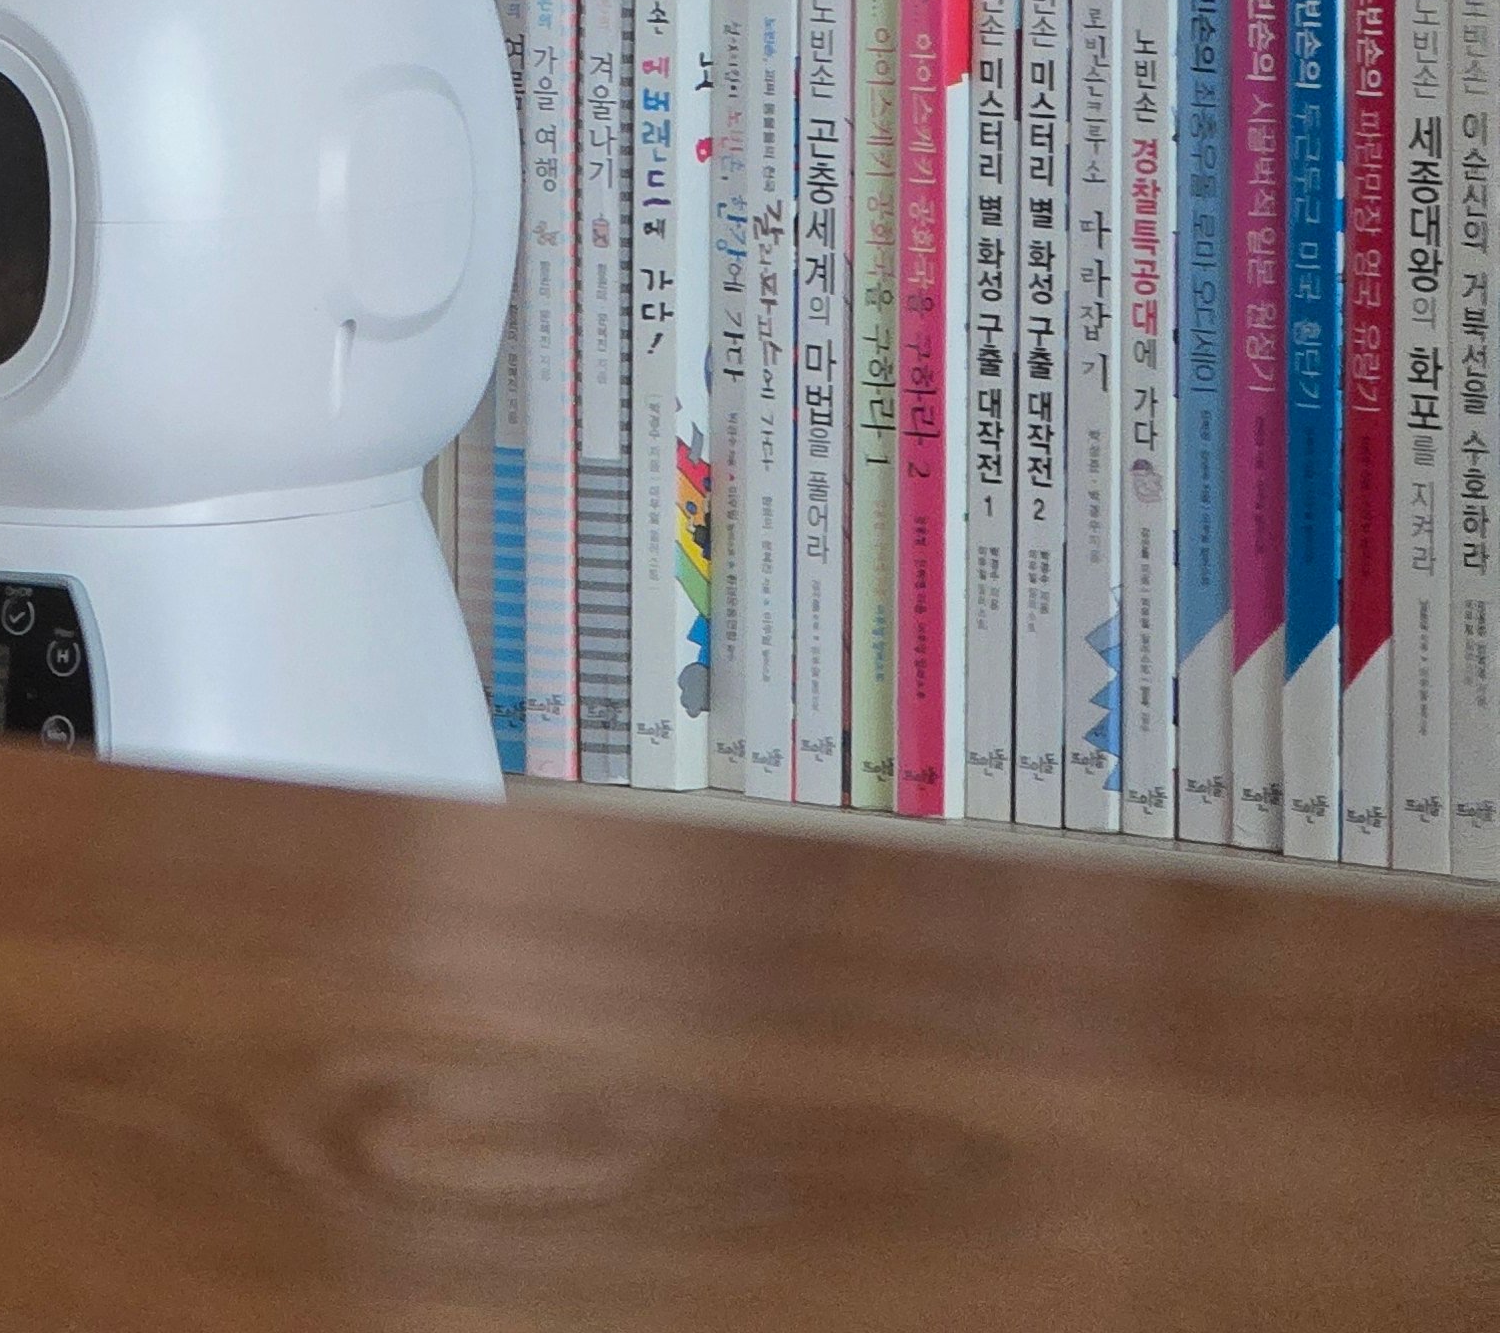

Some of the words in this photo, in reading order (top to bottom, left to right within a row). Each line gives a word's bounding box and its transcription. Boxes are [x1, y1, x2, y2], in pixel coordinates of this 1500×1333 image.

[533, 47, 558, 111] 가을
[588, 53, 617, 188] 겨울나기
[978, 58, 1005, 184] 미스터리
[1029, 59, 1056, 186] 미스터리
[1133, 29, 1158, 123] 노빈손
[535, 125, 558, 193] 여행
[642, 57, 672, 239] 에버랜드에
[1355, 110, 1383, 234] 파란만장
[716, 195, 747, 293] 한강에
[805, 118, 838, 326] 곤충세계의
[979, 195, 1004, 226] 별
[1029, 197, 1054, 229] 별
[1132, 139, 1162, 370] 경찰특공대에
[1246, 226, 1277, 288] 일본
[1407, 116, 1443, 331] 세종대왕의
[977, 237, 1005, 302] 화성
[1028, 240, 1055, 305] 화성
[1295, 242, 1322, 303] 미국
[1354, 250, 1382, 307] 영국
[723, 311, 746, 384] 가다
[861, 325, 896, 437] 구하라
[978, 313, 1004, 378] 구출
[1027, 316, 1054, 380] 구출
[1190, 281, 1217, 393] 오디세이
[903, 333, 940, 445] 구하라
[976, 388, 1004, 484] 대작전
[1134, 387, 1159, 451] 가다
[1408, 347, 1443, 467] 화포를
[761, 415, 775, 472] 가다
[909, 461, 931, 478] 2
[1027, 391, 1055, 488] 대작전
[985, 499, 993, 516] 1
[1033, 499, 1045, 521] 2
[1411, 481, 1435, 576] 지켜라
[1461, 431, 1491, 577] 수호하라
